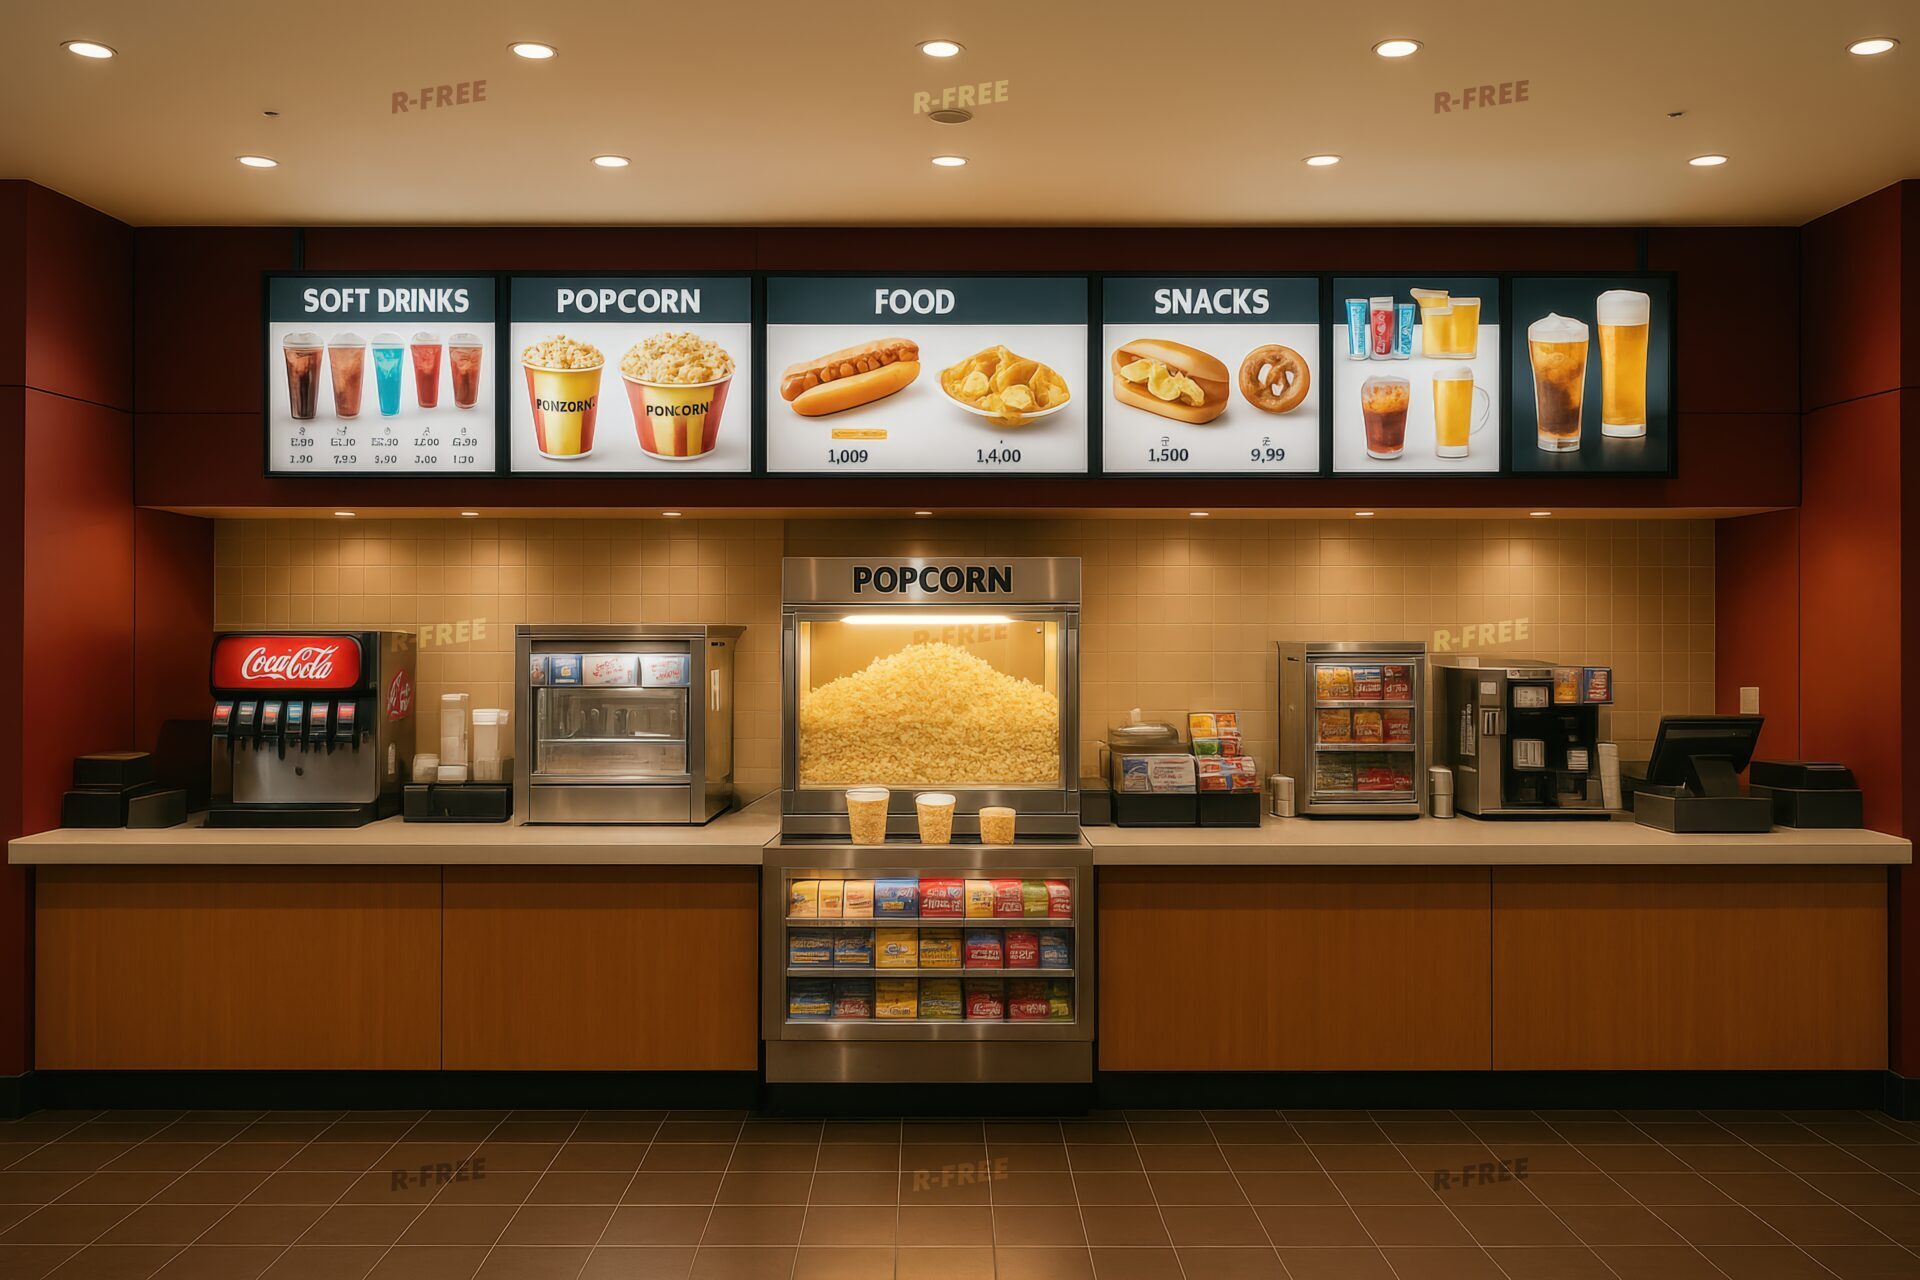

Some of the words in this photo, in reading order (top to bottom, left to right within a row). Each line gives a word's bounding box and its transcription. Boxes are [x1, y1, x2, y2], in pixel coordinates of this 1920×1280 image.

[303, 288, 370, 313] SOFT
[378, 288, 470, 313] DRINKS
[556, 288, 701, 314] POPCORN
[874, 288, 956, 315] FOOD
[1153, 287, 1270, 315] SNACKS
[646, 402, 709, 417] PONCORN
[828, 449, 868, 464] 1,009
[976, 449, 1021, 464] 1,4,00
[1251, 448, 1285, 463] 9,99
[853, 566, 1013, 594] POPCORN
